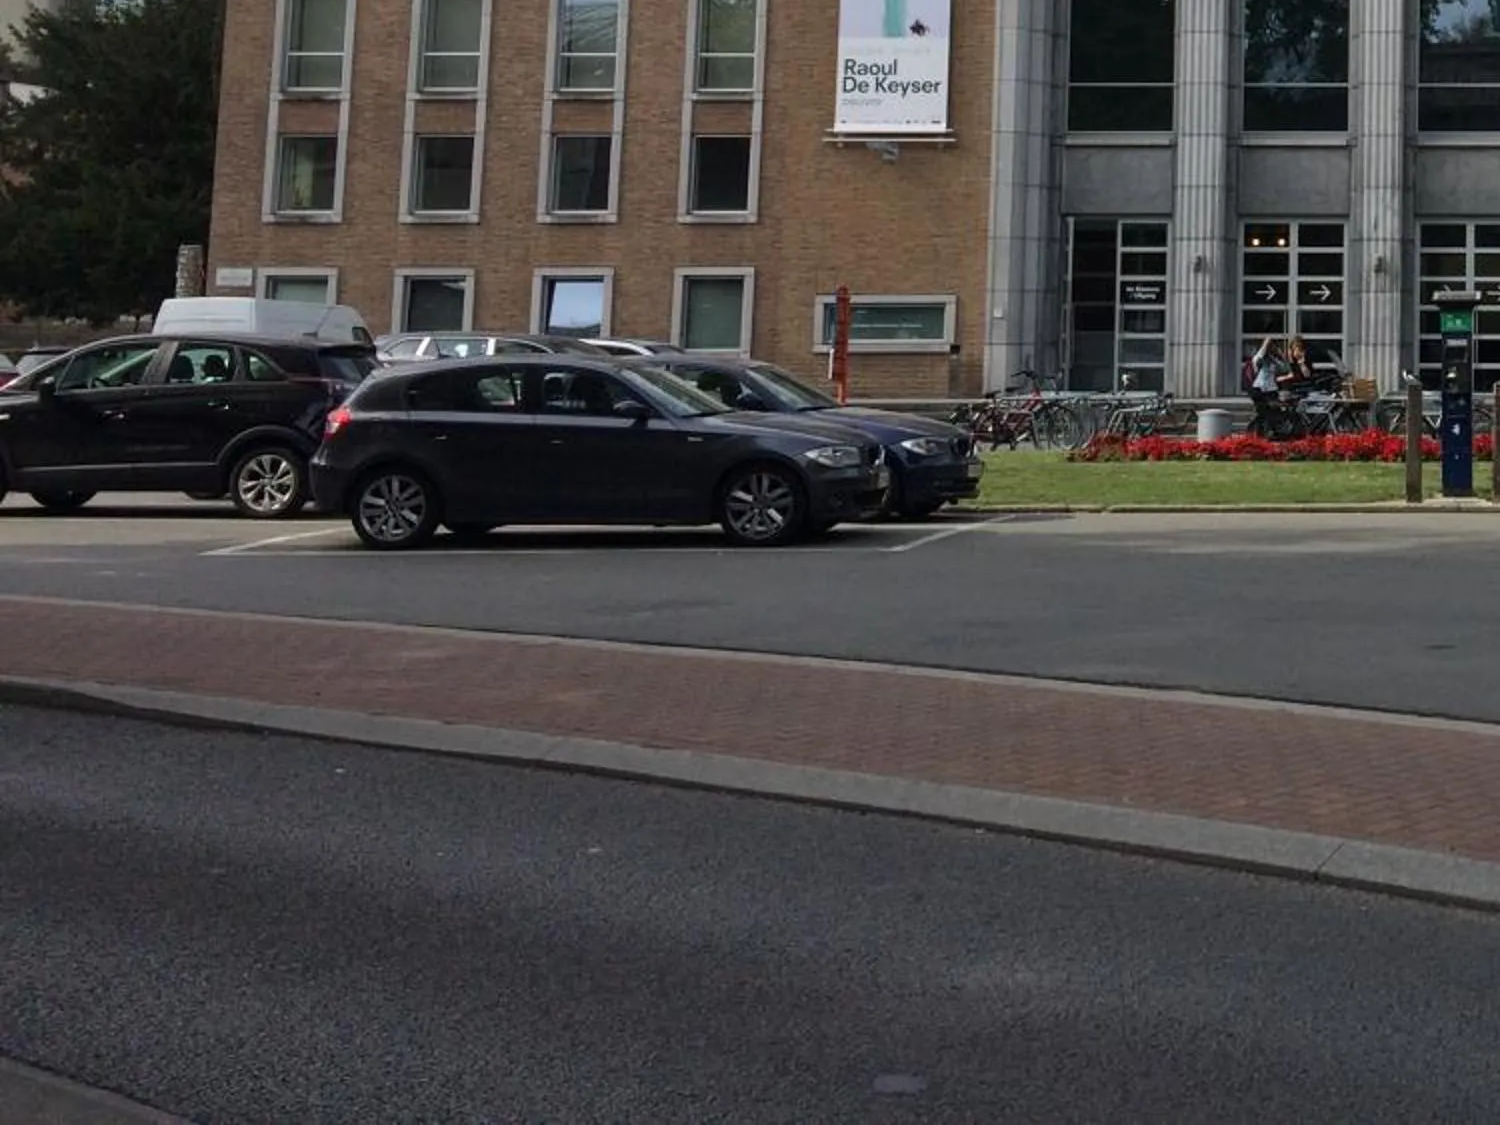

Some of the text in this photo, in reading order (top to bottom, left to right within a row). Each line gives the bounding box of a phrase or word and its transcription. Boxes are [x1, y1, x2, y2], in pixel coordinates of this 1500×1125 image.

[843, 58, 898, 76] Raoul
[842, 76, 942, 99] De Keyser
